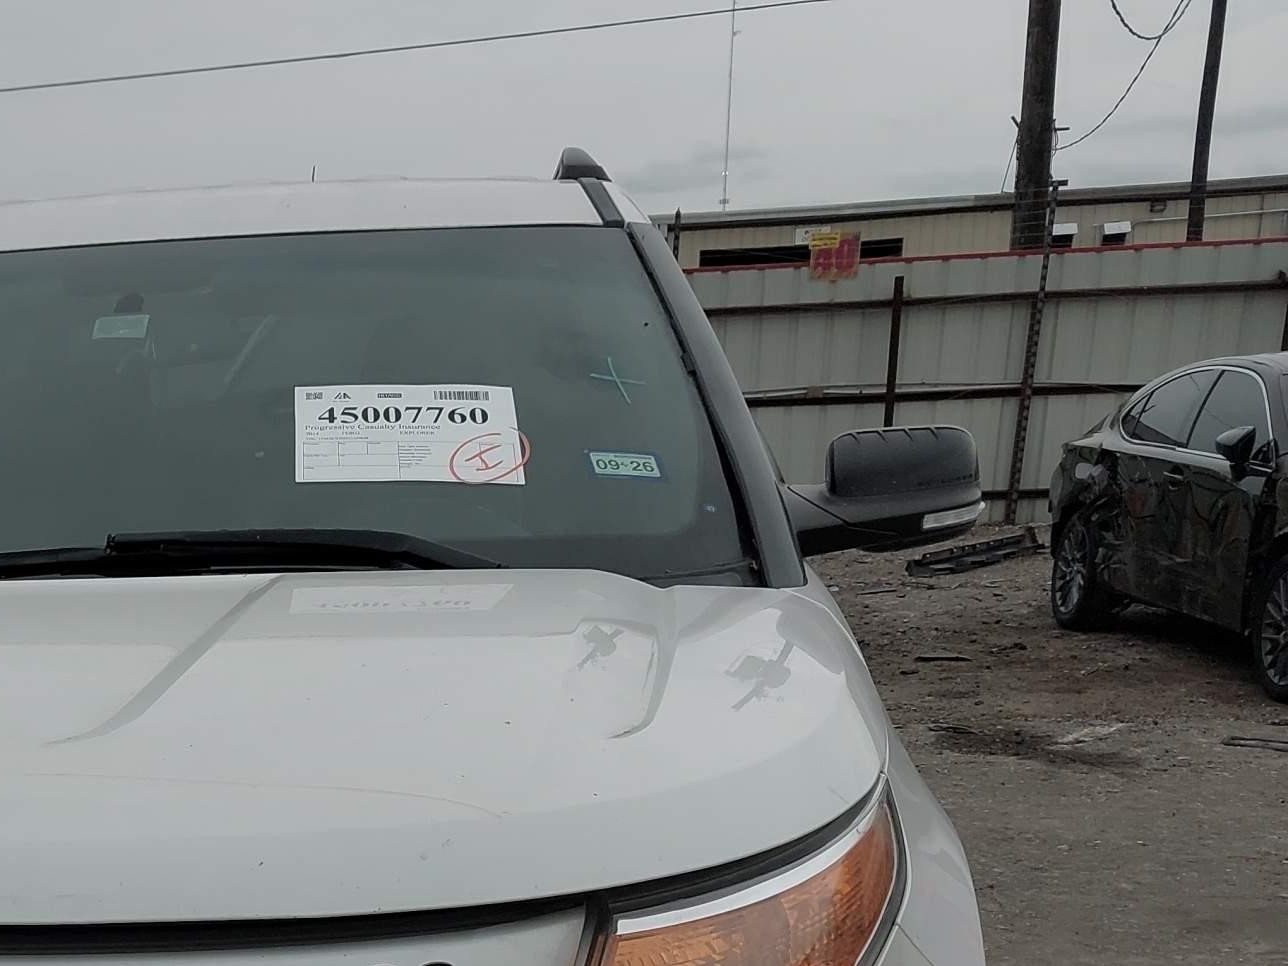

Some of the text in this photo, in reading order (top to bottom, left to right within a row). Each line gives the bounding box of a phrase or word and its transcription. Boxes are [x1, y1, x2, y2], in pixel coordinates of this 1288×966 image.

[318, 406, 489, 424] 45007760
[305, 424, 355, 432] Progressive
[595, 458, 655, 473] 09 26
